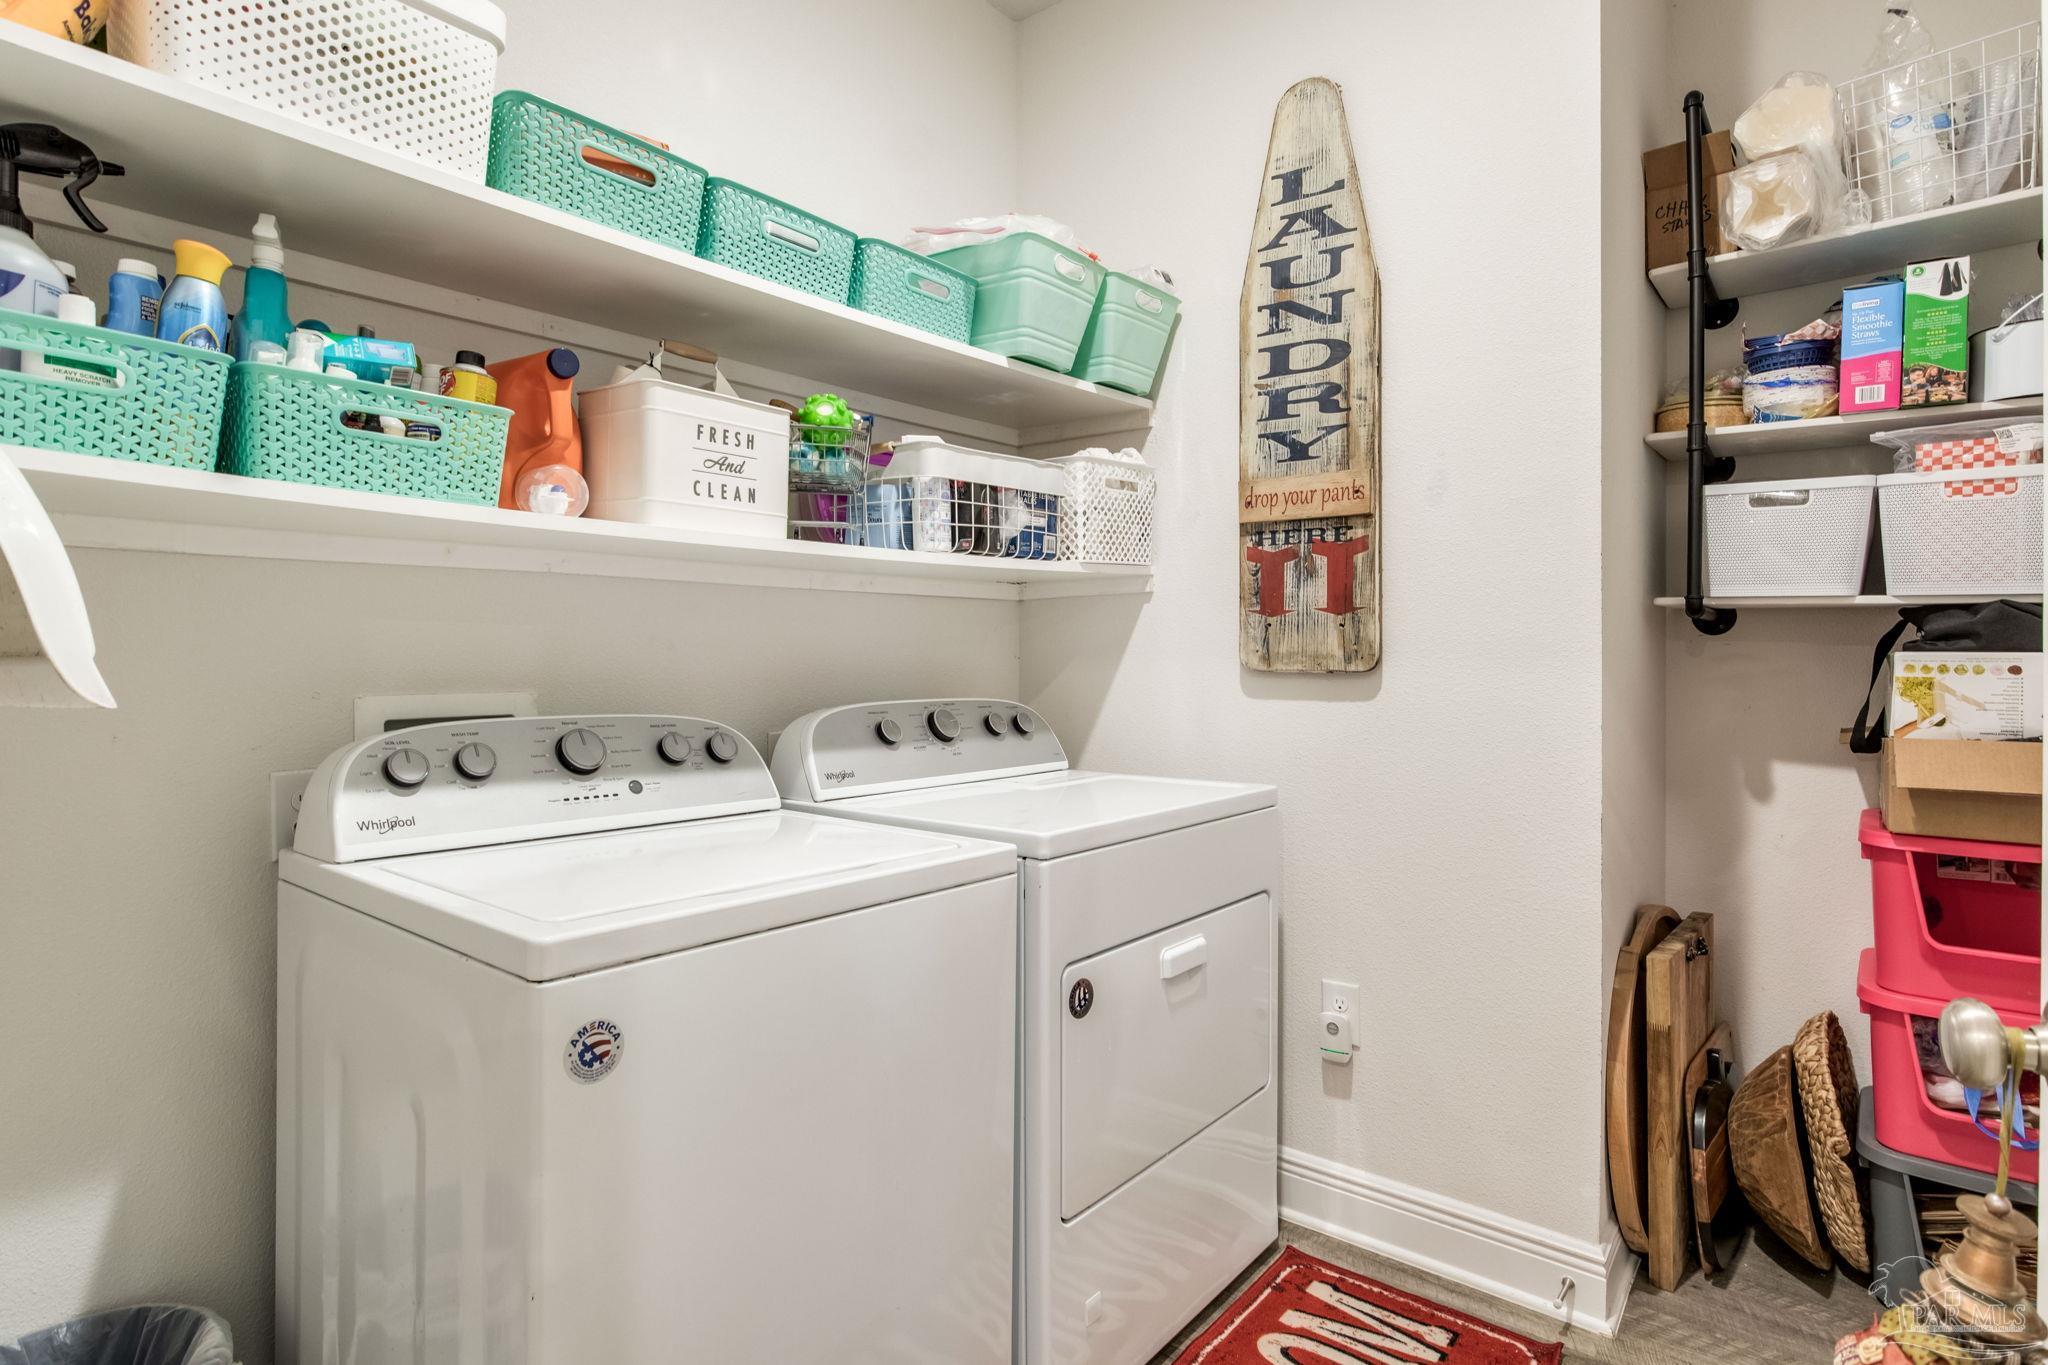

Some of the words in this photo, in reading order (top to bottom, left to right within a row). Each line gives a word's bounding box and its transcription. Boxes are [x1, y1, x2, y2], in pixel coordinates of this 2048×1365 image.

[1257, 165, 1358, 464] LAUNDRY
[1852, 313, 1886, 324] Flexible
[1852, 320, 1893, 332] Smoothie
[1852, 329, 1880, 340] Straws
[53, 367, 78, 377] HEAVY
[79, 372, 112, 385] SCRATCH
[65, 376, 101, 387] REMOVER
[696, 423, 755, 450] FRESH
[703, 456, 746, 475] And
[693, 479, 757, 504] CLEAN
[1244, 486, 1279, 515] drop
[1281, 488, 1317, 514] your
[1319, 479, 1366, 511] pants
[1254, 525, 1354, 547] HERE
[823, 769, 856, 783] Whirlpool
[356, 815, 416, 835] Whirlpool
[570, 1020, 621, 1048] AMERICA
